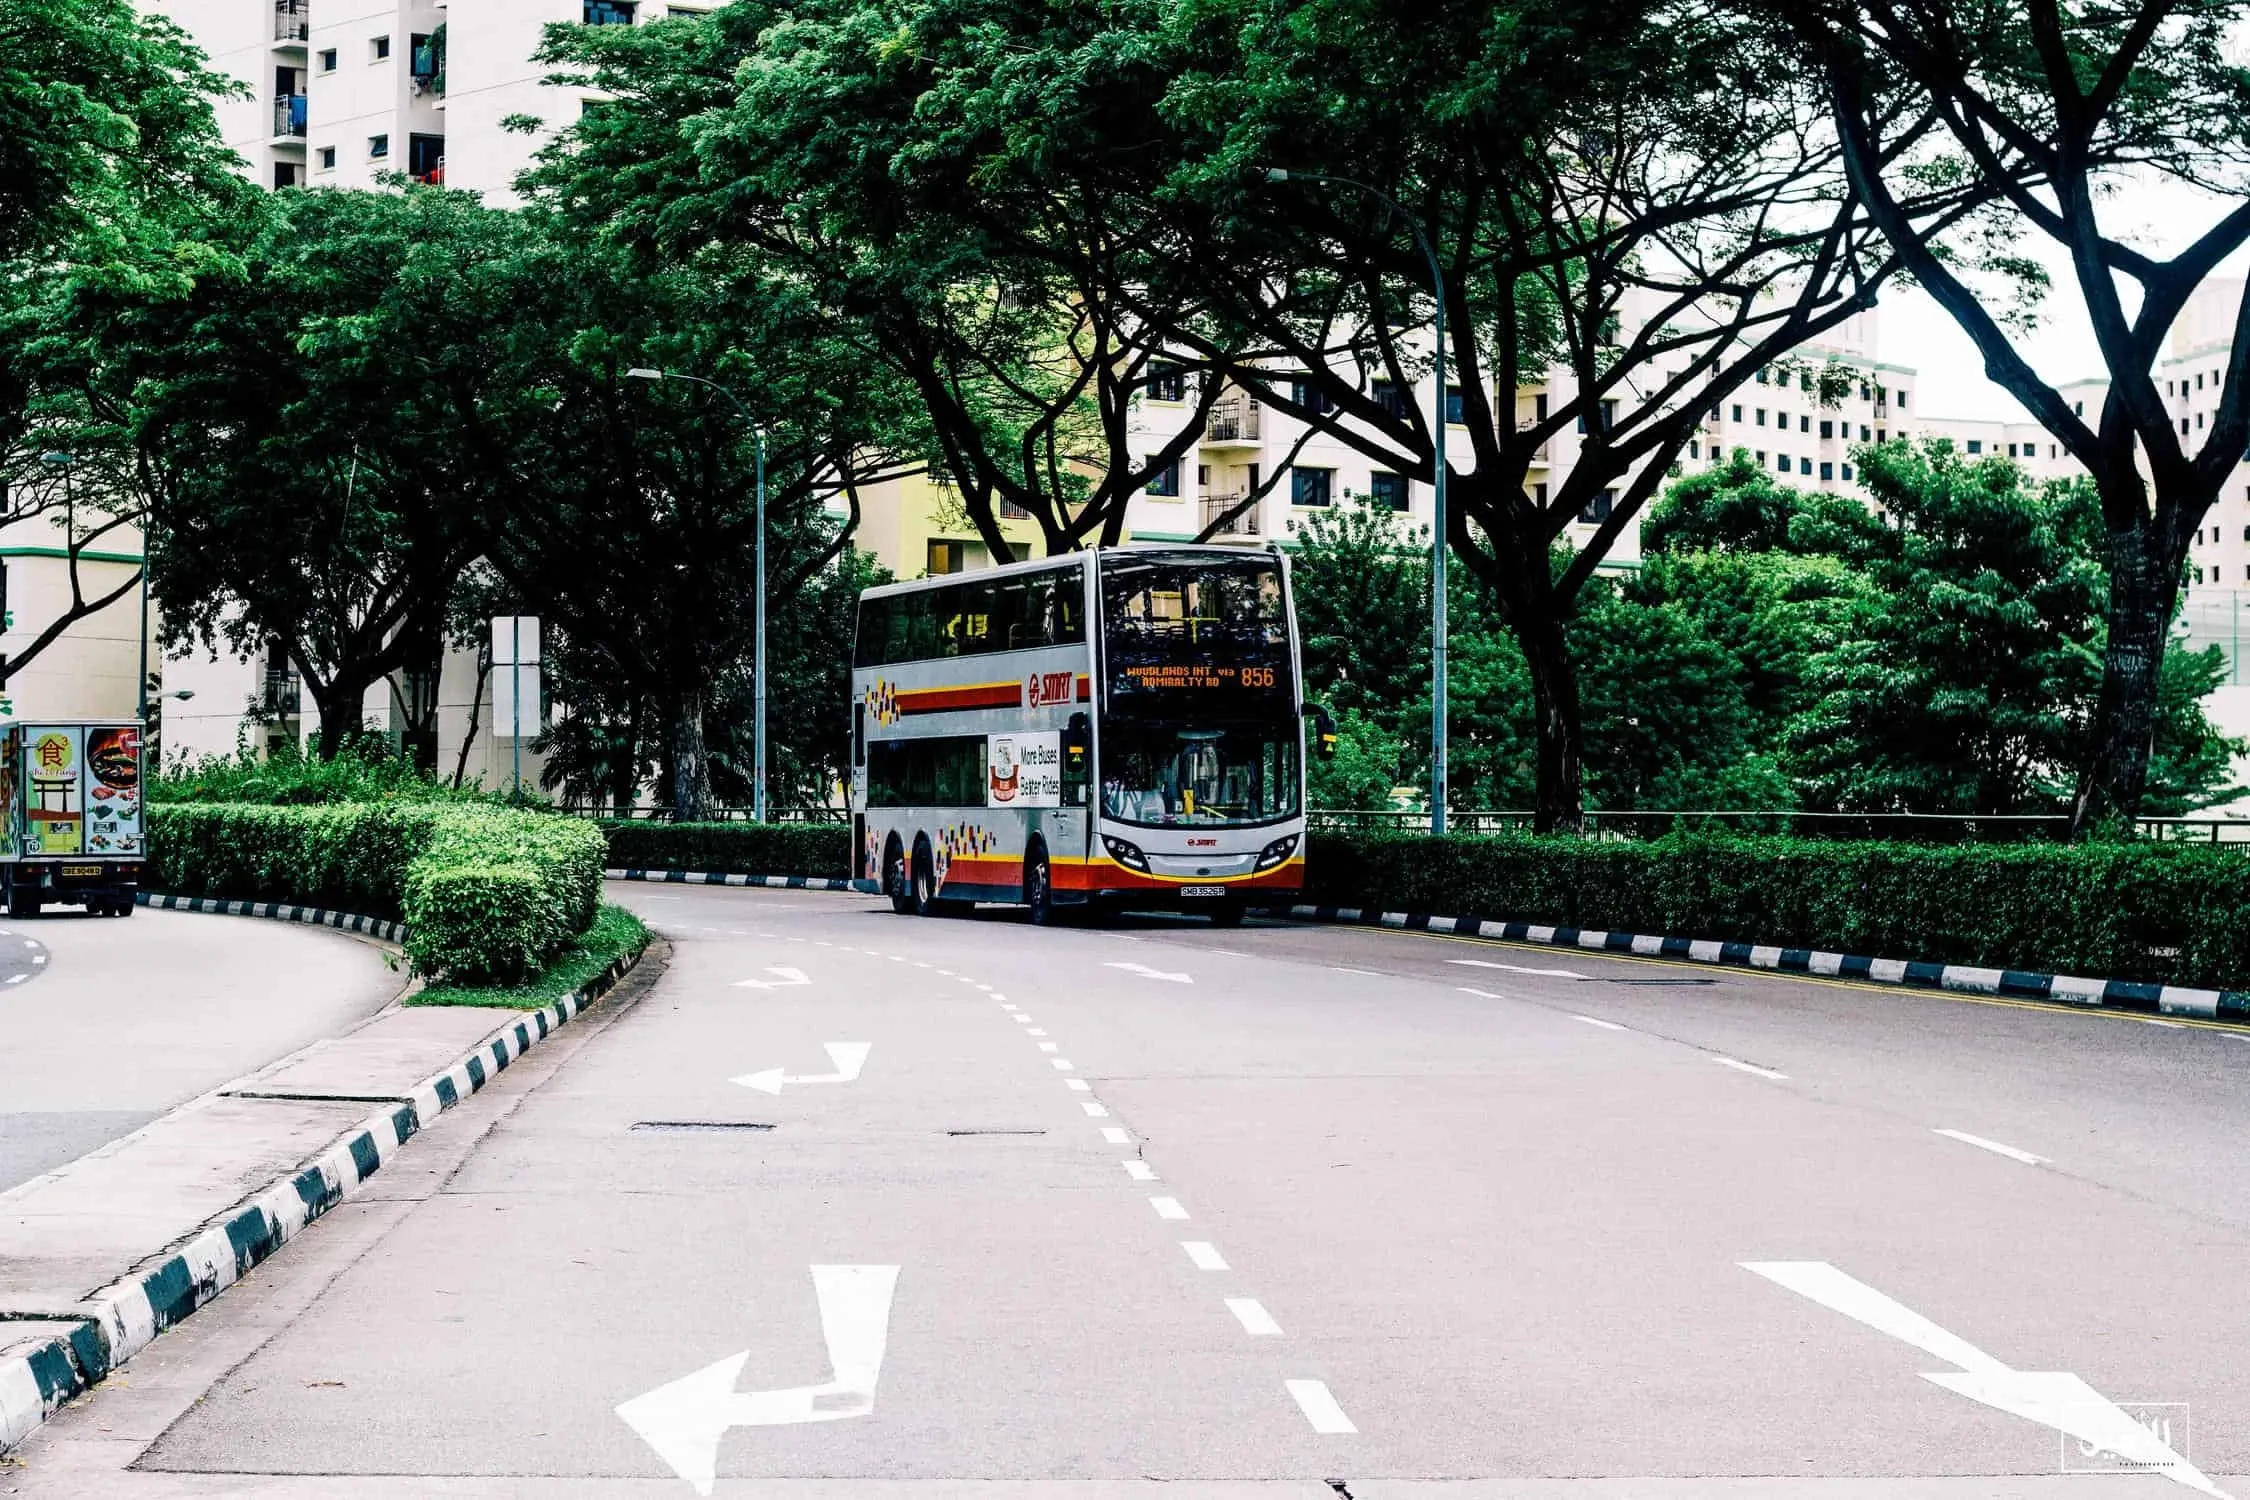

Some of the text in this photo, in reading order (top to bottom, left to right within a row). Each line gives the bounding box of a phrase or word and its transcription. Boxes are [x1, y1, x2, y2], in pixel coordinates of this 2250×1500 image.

[1040, 672, 1072, 701] SMRT
[1241, 667, 1274, 687] 856
[37, 738, 65, 767] 食
[1020, 745, 1057, 765] More Buses
[1020, 775, 1059, 796] Better Rides
